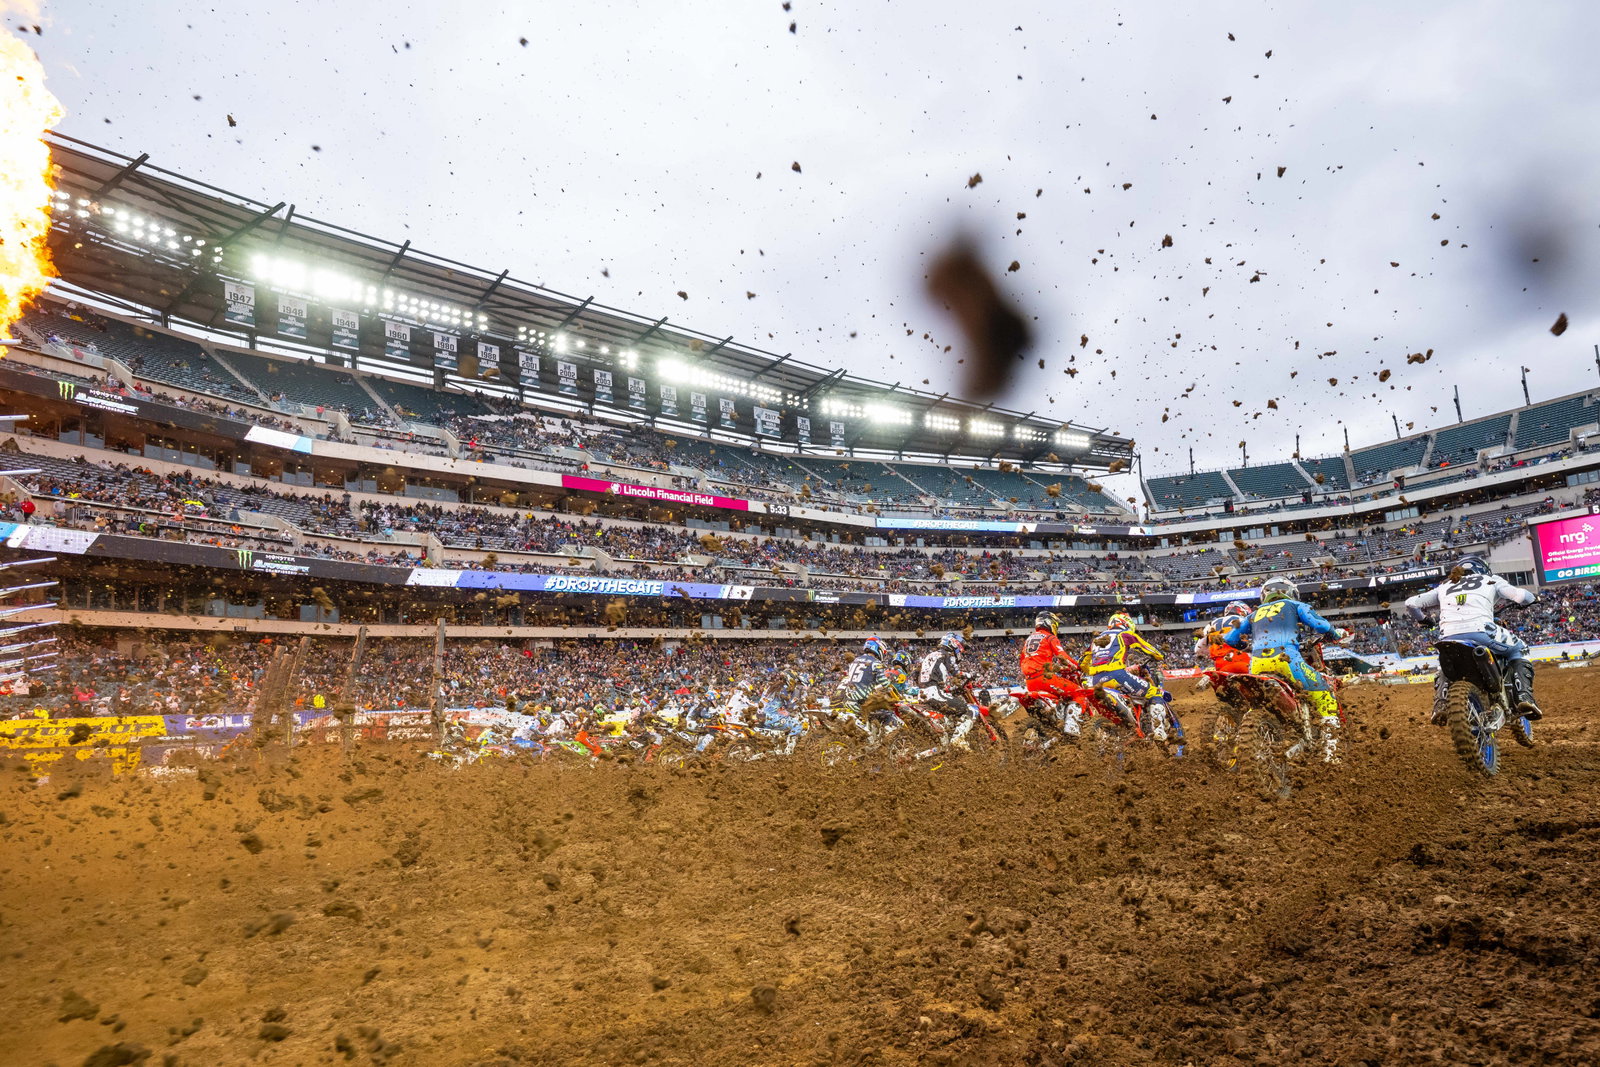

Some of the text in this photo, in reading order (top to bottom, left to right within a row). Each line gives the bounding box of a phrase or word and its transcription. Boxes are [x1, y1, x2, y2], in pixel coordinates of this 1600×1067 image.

[228, 291, 252, 304] 1947
[282, 305, 304, 317] 1948
[335, 317, 356, 329] 1949
[388, 330, 408, 341] 1960
[437, 341, 455, 351] 1980
[521, 360, 538, 370] 2001
[623, 485, 714, 506] Lincoln Financial Field
[769, 504, 788, 515] 5:33
[1557, 570, 1573, 578] GO
[544, 577, 663, 595] #DROPTHEGATE
[1446, 575, 1484, 596] 28
[943, 596, 1016, 607] #DROPTHEGATE
